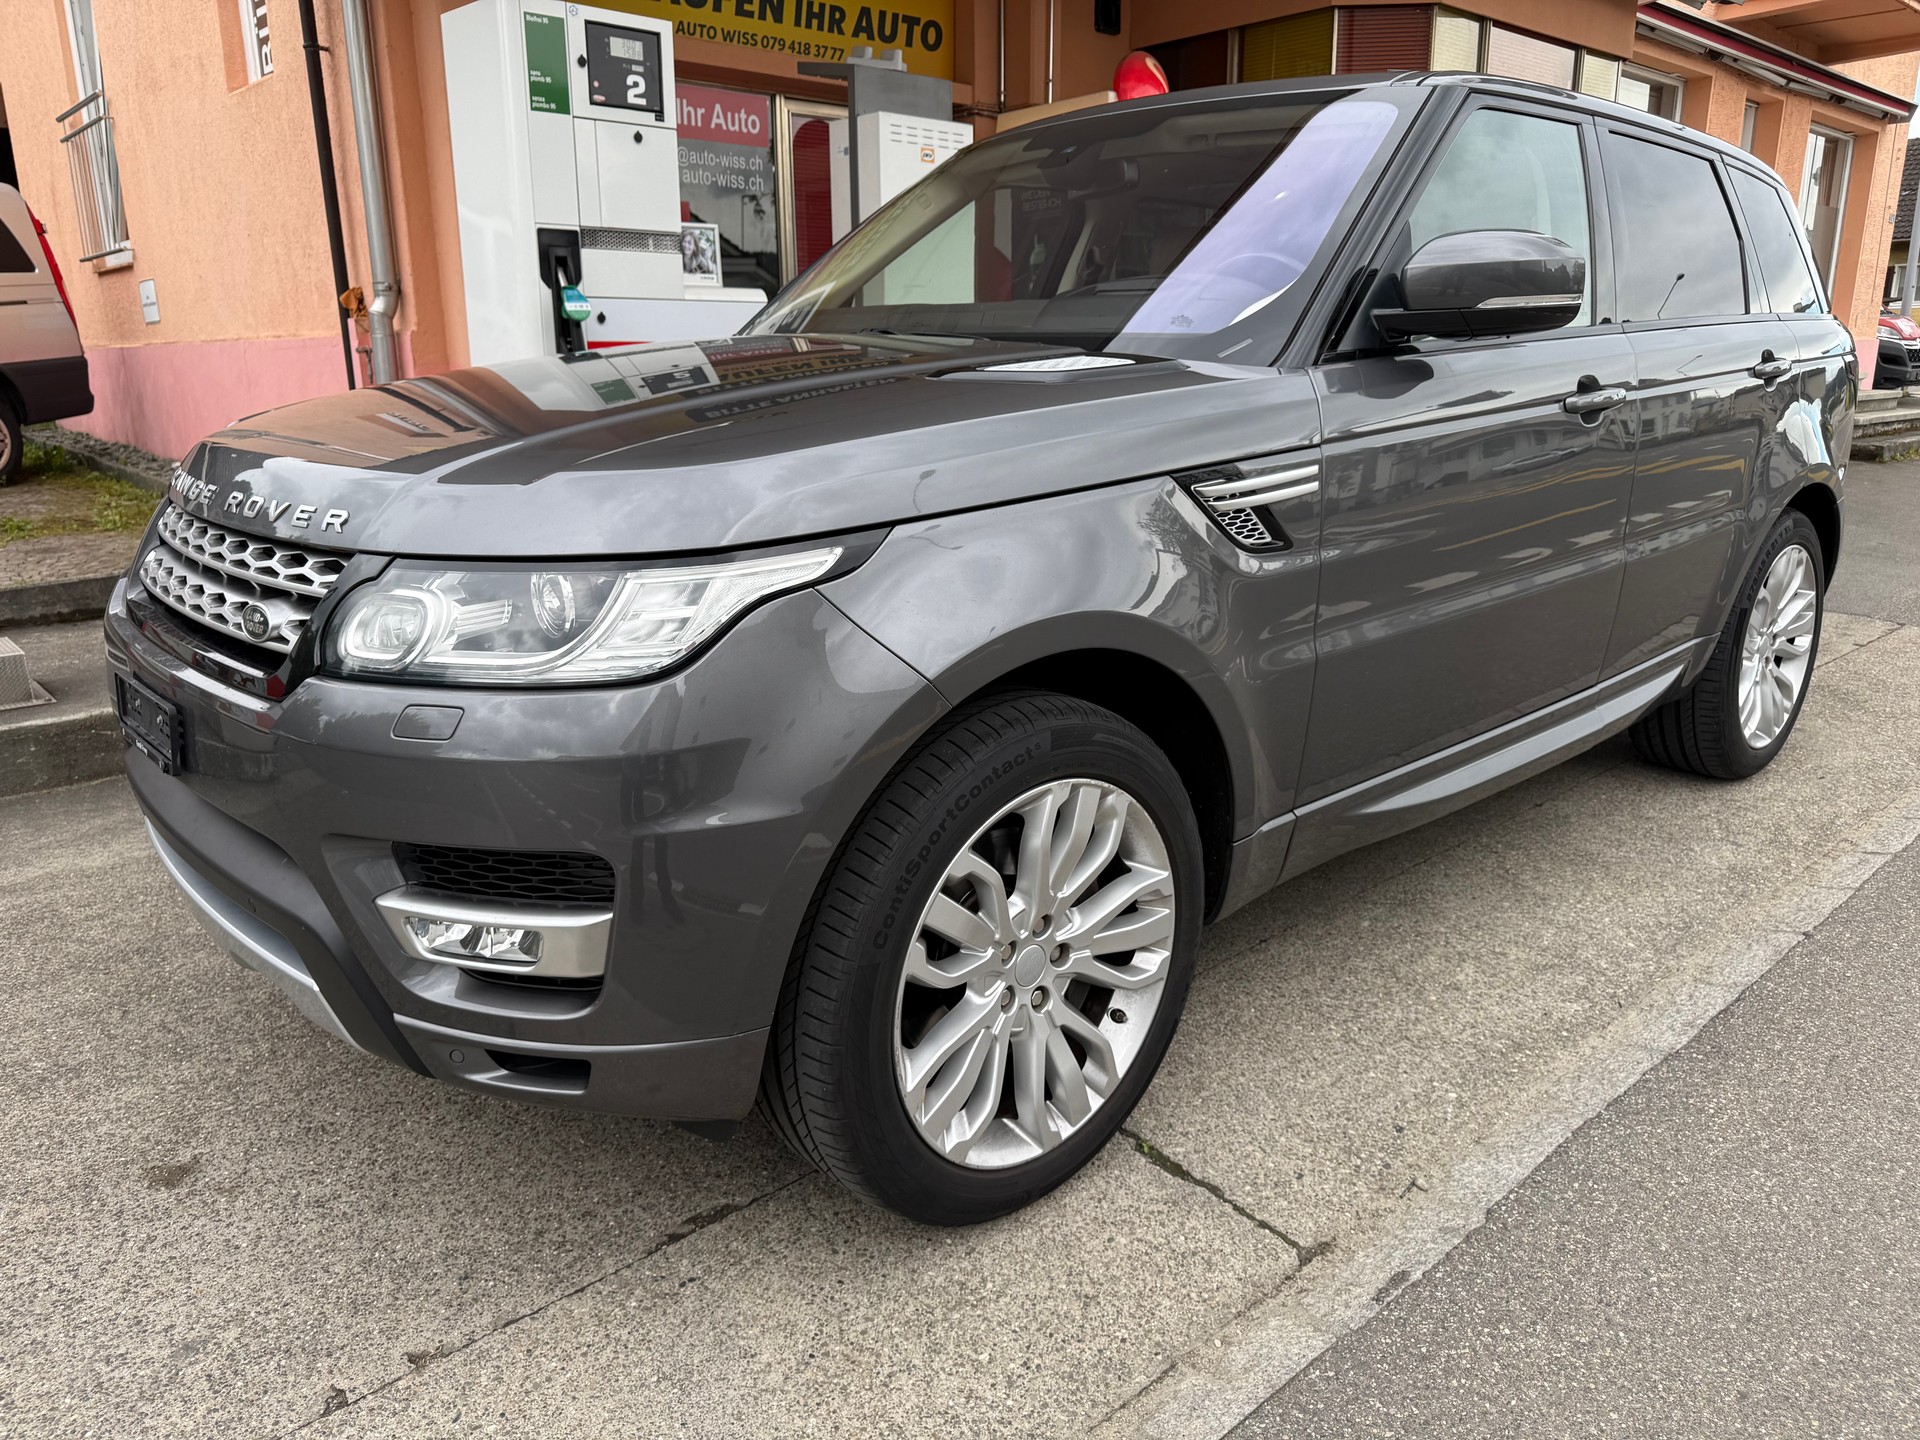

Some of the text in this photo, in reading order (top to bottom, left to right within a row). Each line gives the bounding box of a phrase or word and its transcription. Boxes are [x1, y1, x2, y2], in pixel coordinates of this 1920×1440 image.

[675, 20, 718, 40] AUTO
[721, 28, 759, 48] WISS
[760, 35, 786, 51] 079
[788, 40, 811, 56] 418
[794, 0, 847, 36] IHR
[851, 6, 943, 52] AUTO
[626, 74, 647, 106] 2
[676, 98, 761, 134] Ihr Auto
[682, 167, 765, 191] auto-wiss.ch
[224, 491, 350, 534] ROVER
